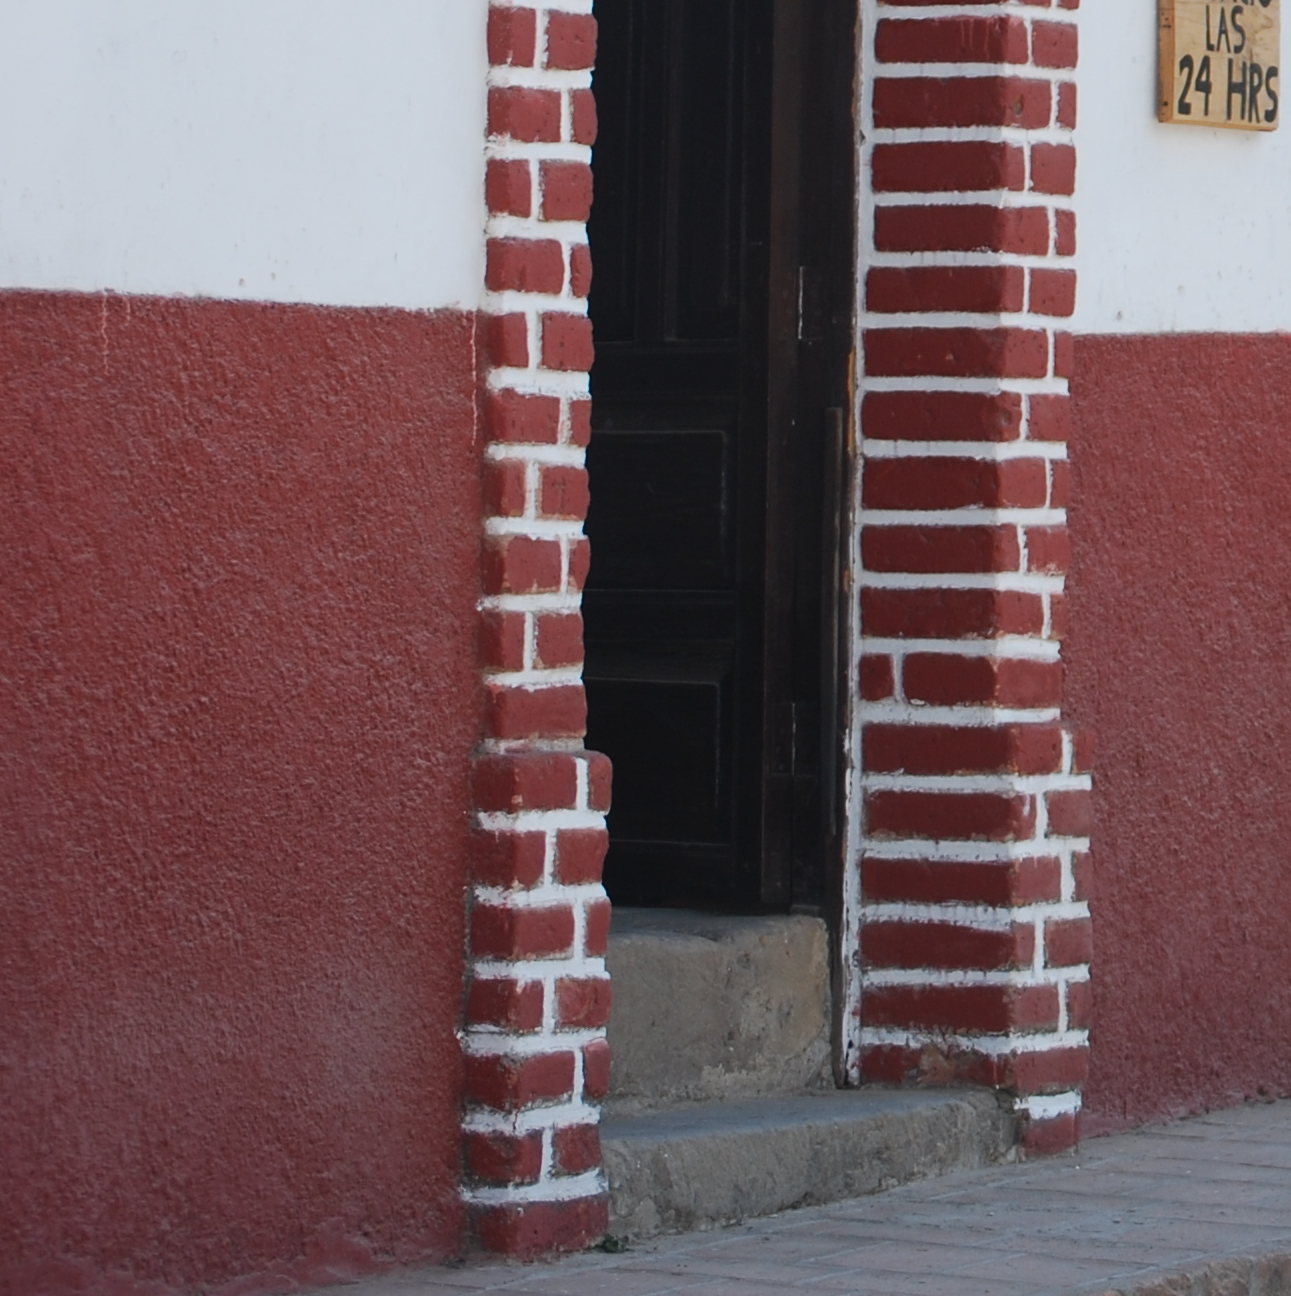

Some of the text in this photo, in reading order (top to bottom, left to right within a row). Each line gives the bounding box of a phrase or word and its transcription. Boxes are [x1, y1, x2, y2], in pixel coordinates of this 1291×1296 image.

[1205, 4, 1246, 54] LAS
[1178, 54, 1279, 124] 24 HRS
